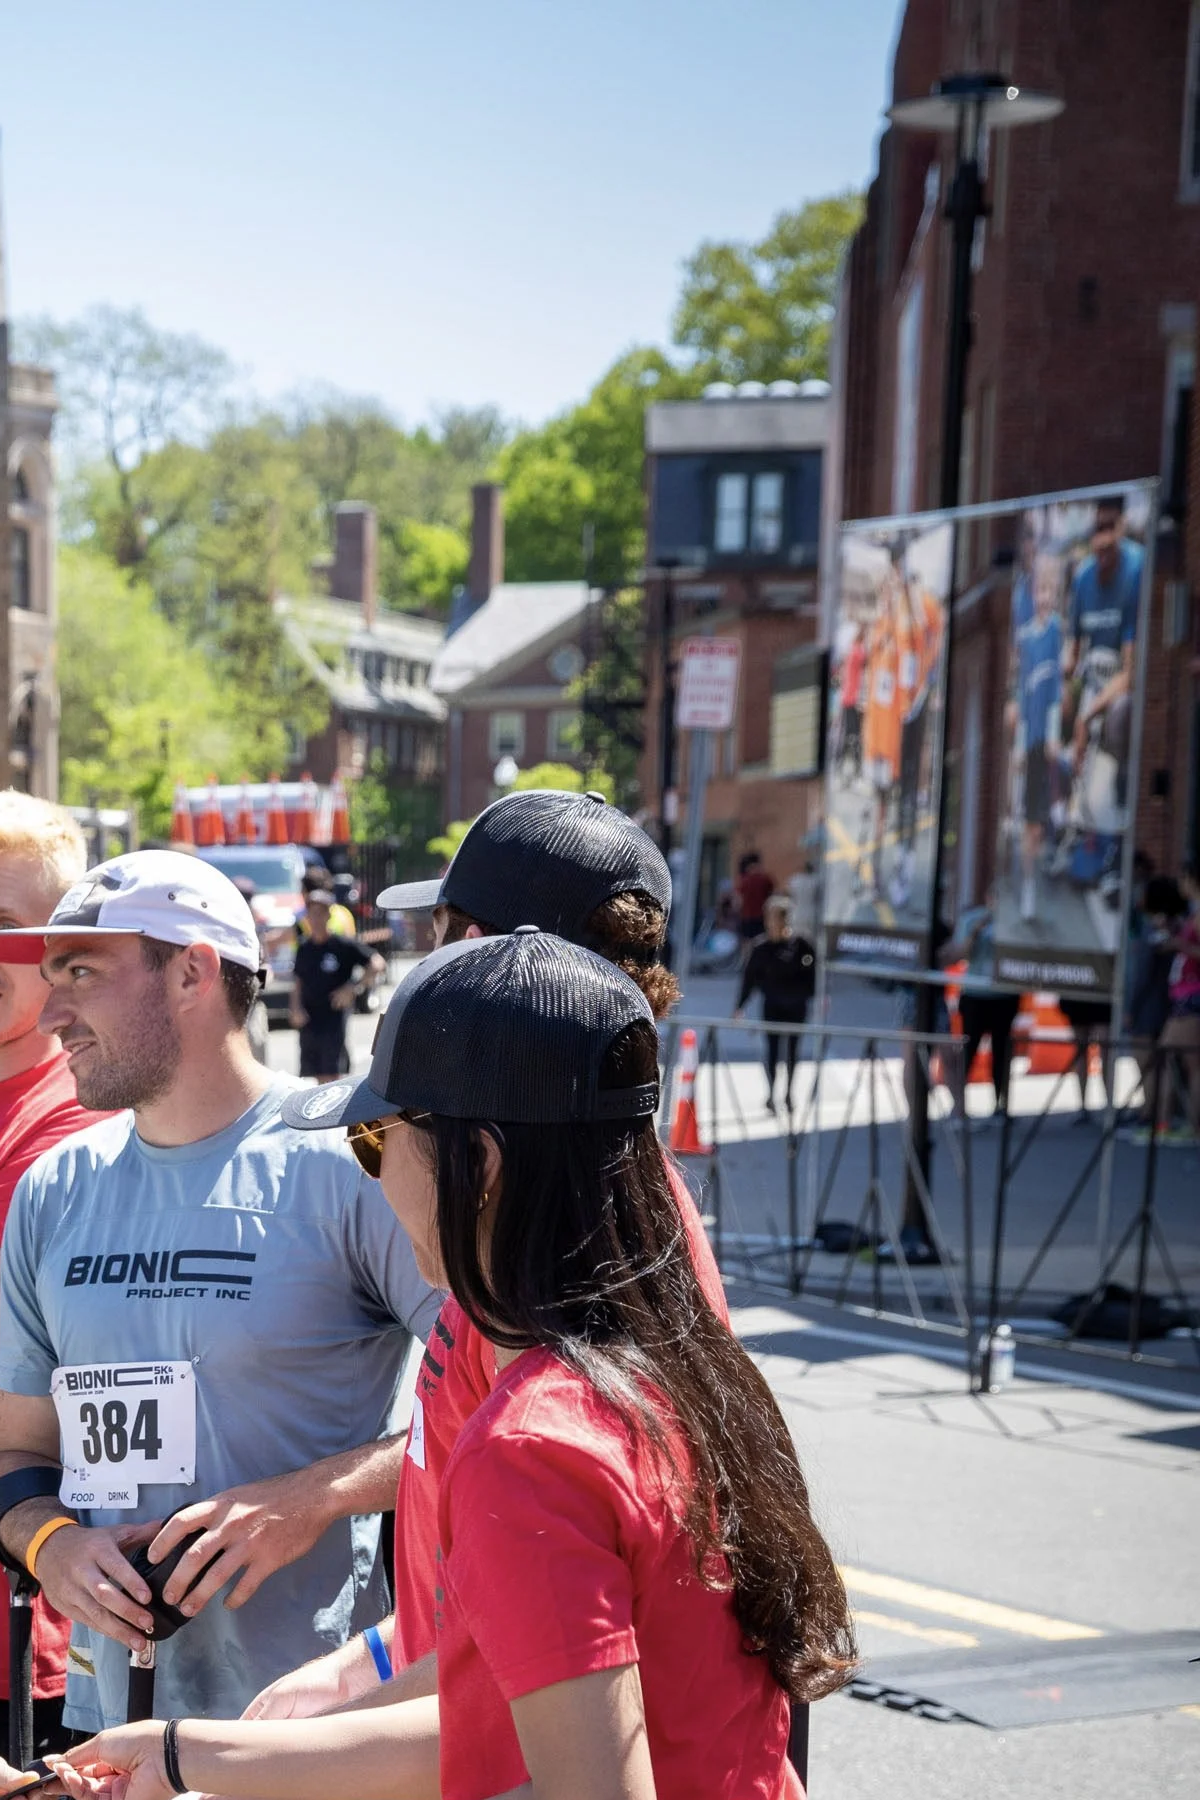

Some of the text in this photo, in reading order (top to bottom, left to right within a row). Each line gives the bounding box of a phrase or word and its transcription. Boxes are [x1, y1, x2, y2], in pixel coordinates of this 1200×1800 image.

[64, 1249, 256, 1287] BIONIC
[126, 1288, 251, 1300] PROJECT INC
[65, 1366, 154, 1391] BIONIC
[80, 1399, 162, 1464] 384
[70, 1491, 130, 1502] FOOD DRINK
